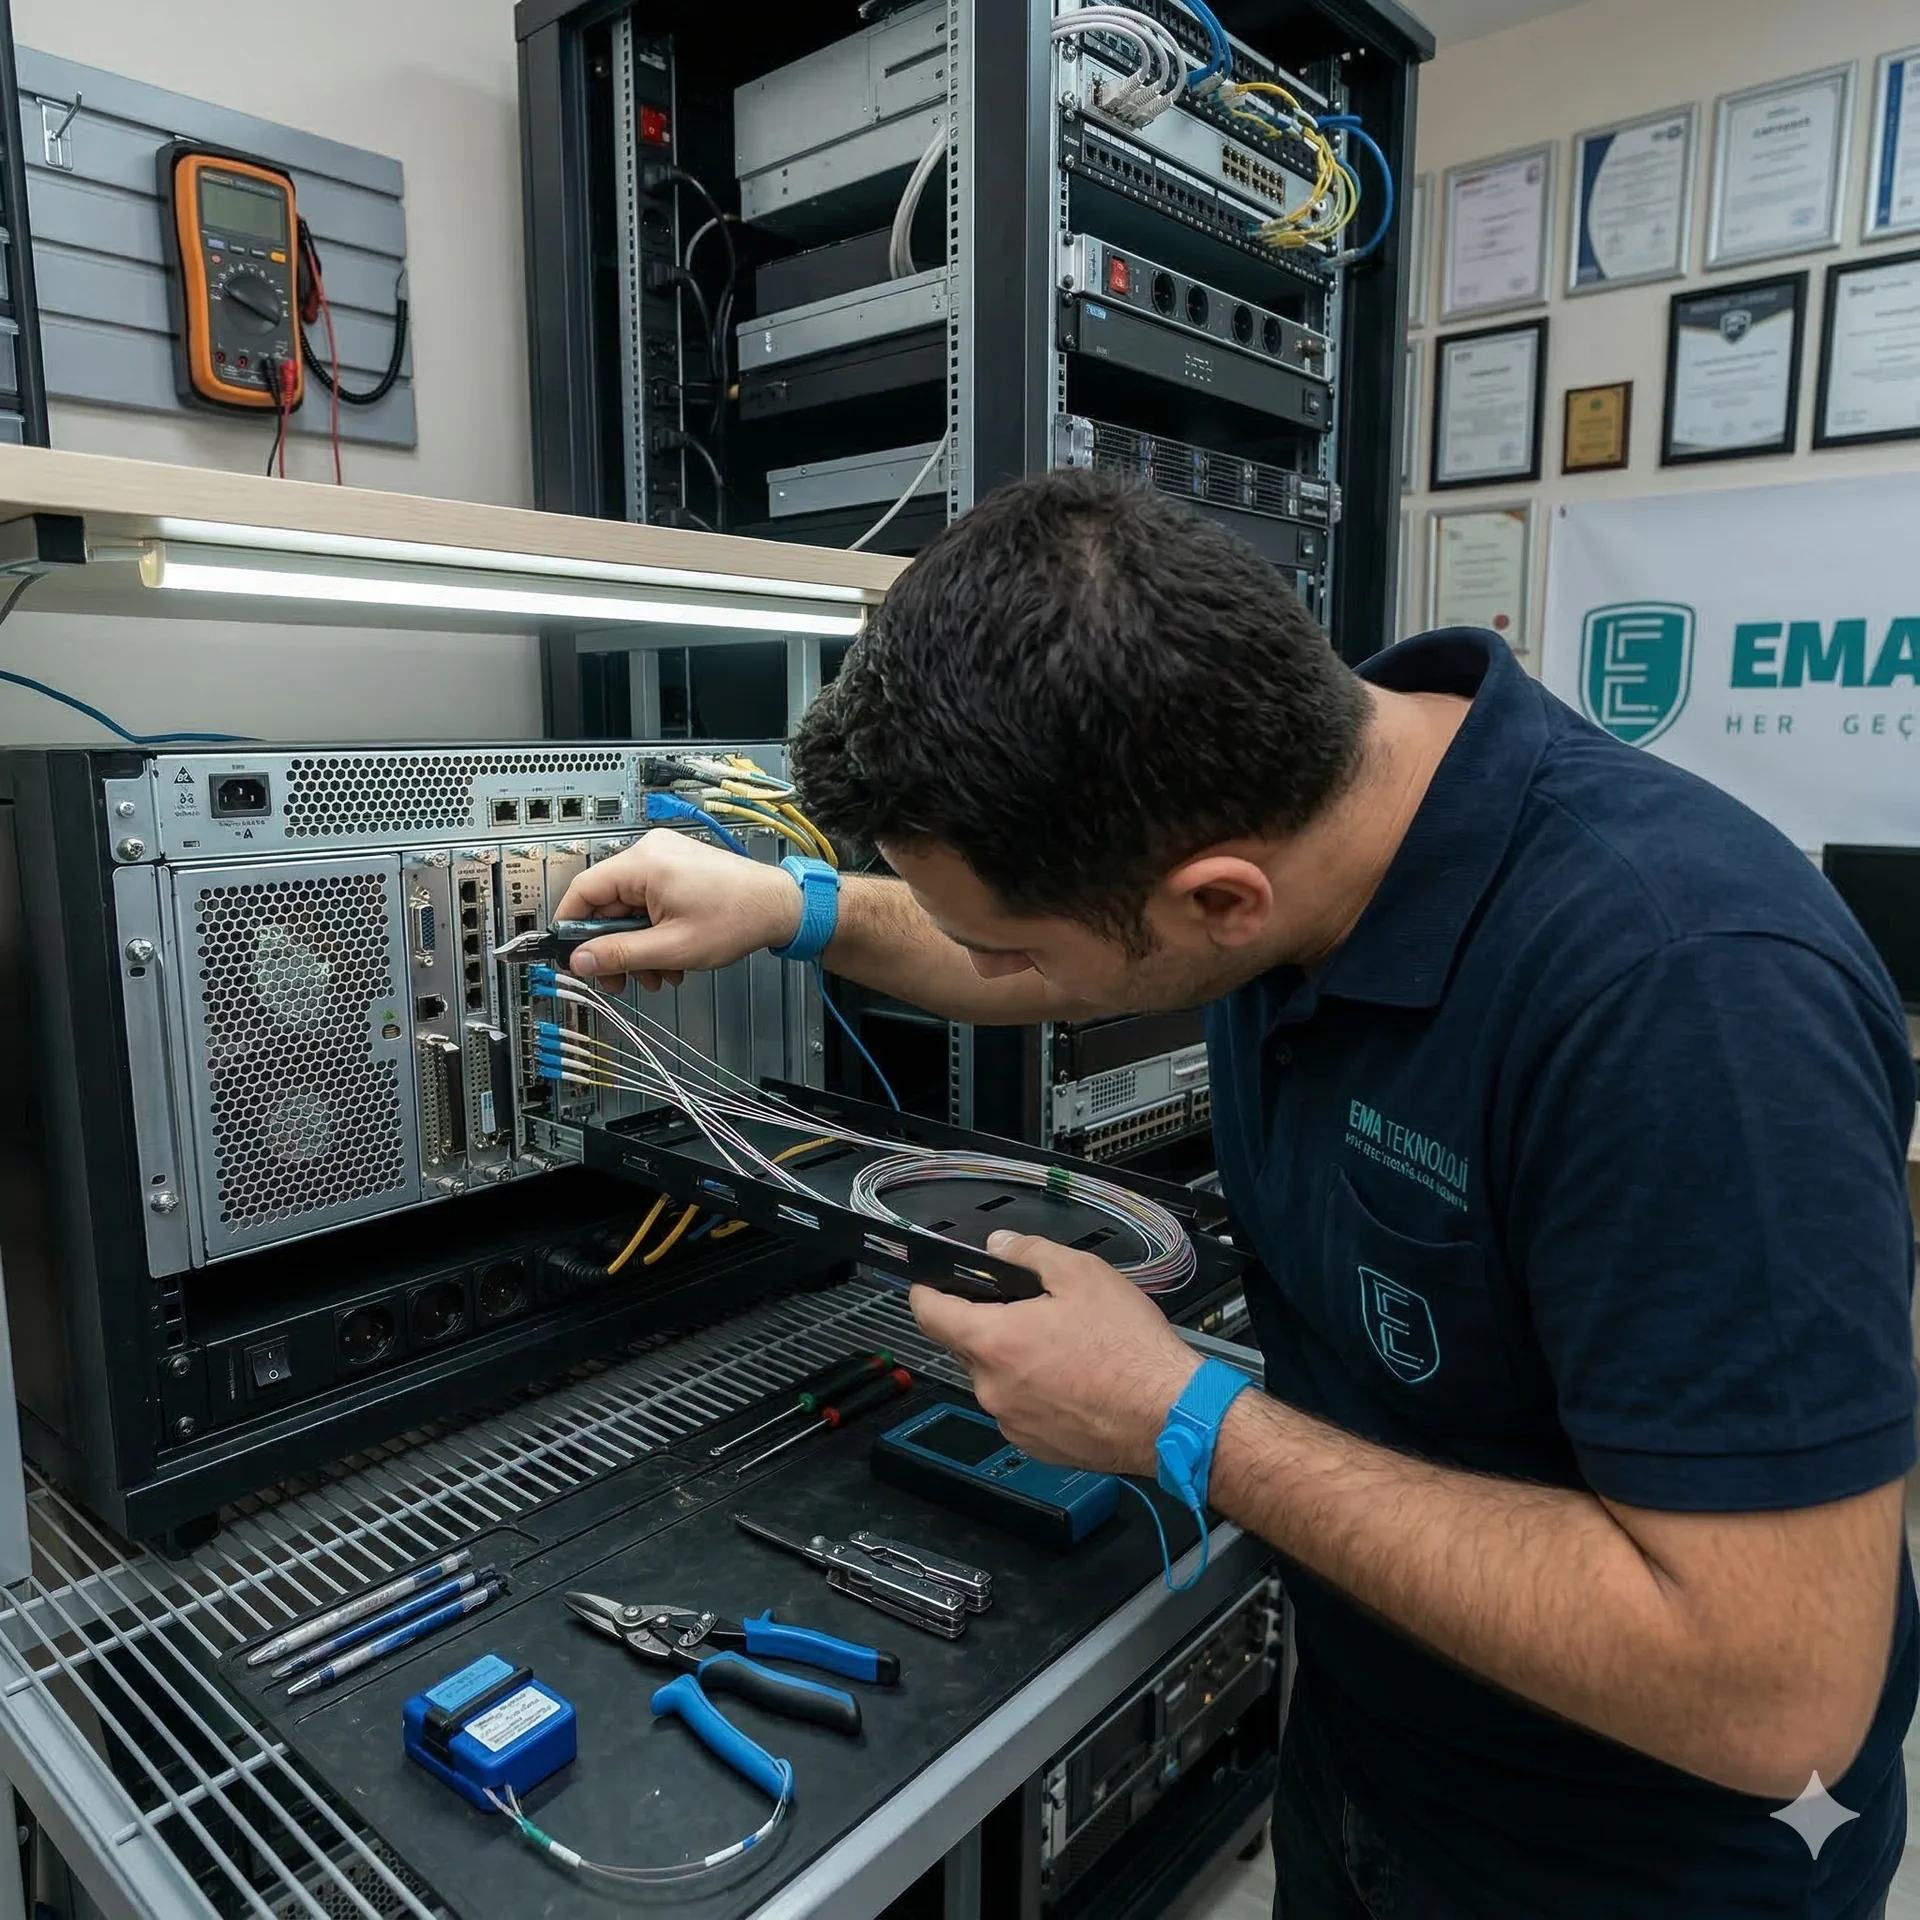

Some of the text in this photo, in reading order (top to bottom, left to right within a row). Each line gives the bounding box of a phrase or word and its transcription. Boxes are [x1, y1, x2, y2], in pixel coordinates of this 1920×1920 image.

[1730, 616, 1920, 688] EMA
[1726, 713, 1915, 741] HER GEÇ
[1349, 1099, 1382, 1143] EMA
